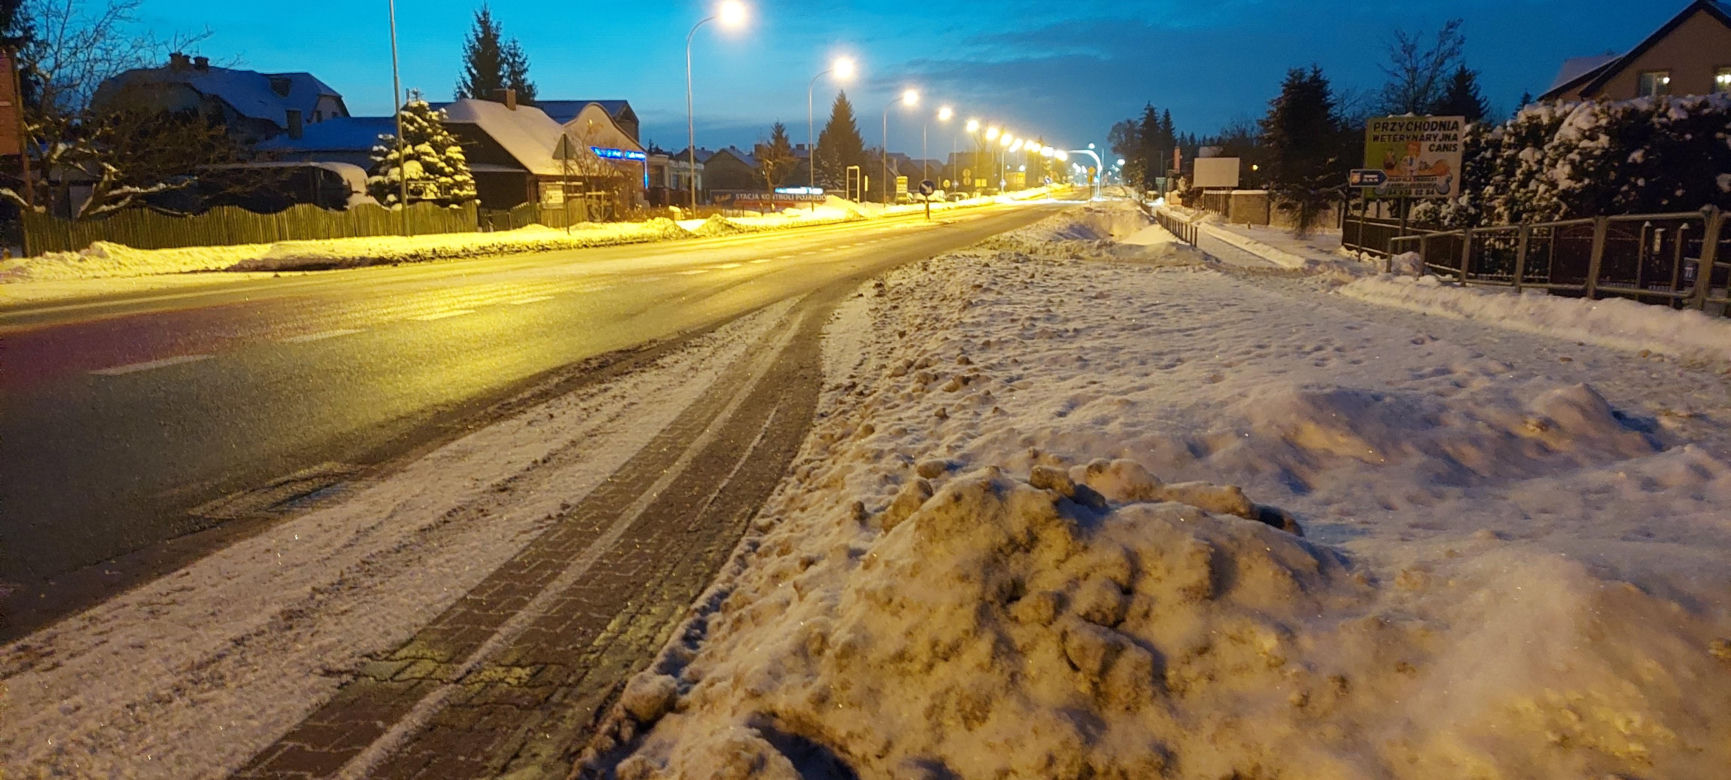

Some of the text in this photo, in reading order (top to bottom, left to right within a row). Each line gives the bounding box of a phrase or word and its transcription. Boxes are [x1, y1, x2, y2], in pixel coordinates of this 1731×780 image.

[1373, 120, 1459, 132] PRZYCHODNIA
[1372, 133, 1458, 143] WETERYNARYJNA
[1428, 143, 1458, 152] CANIS
[796, 193, 829, 201] POJAZDÓ
